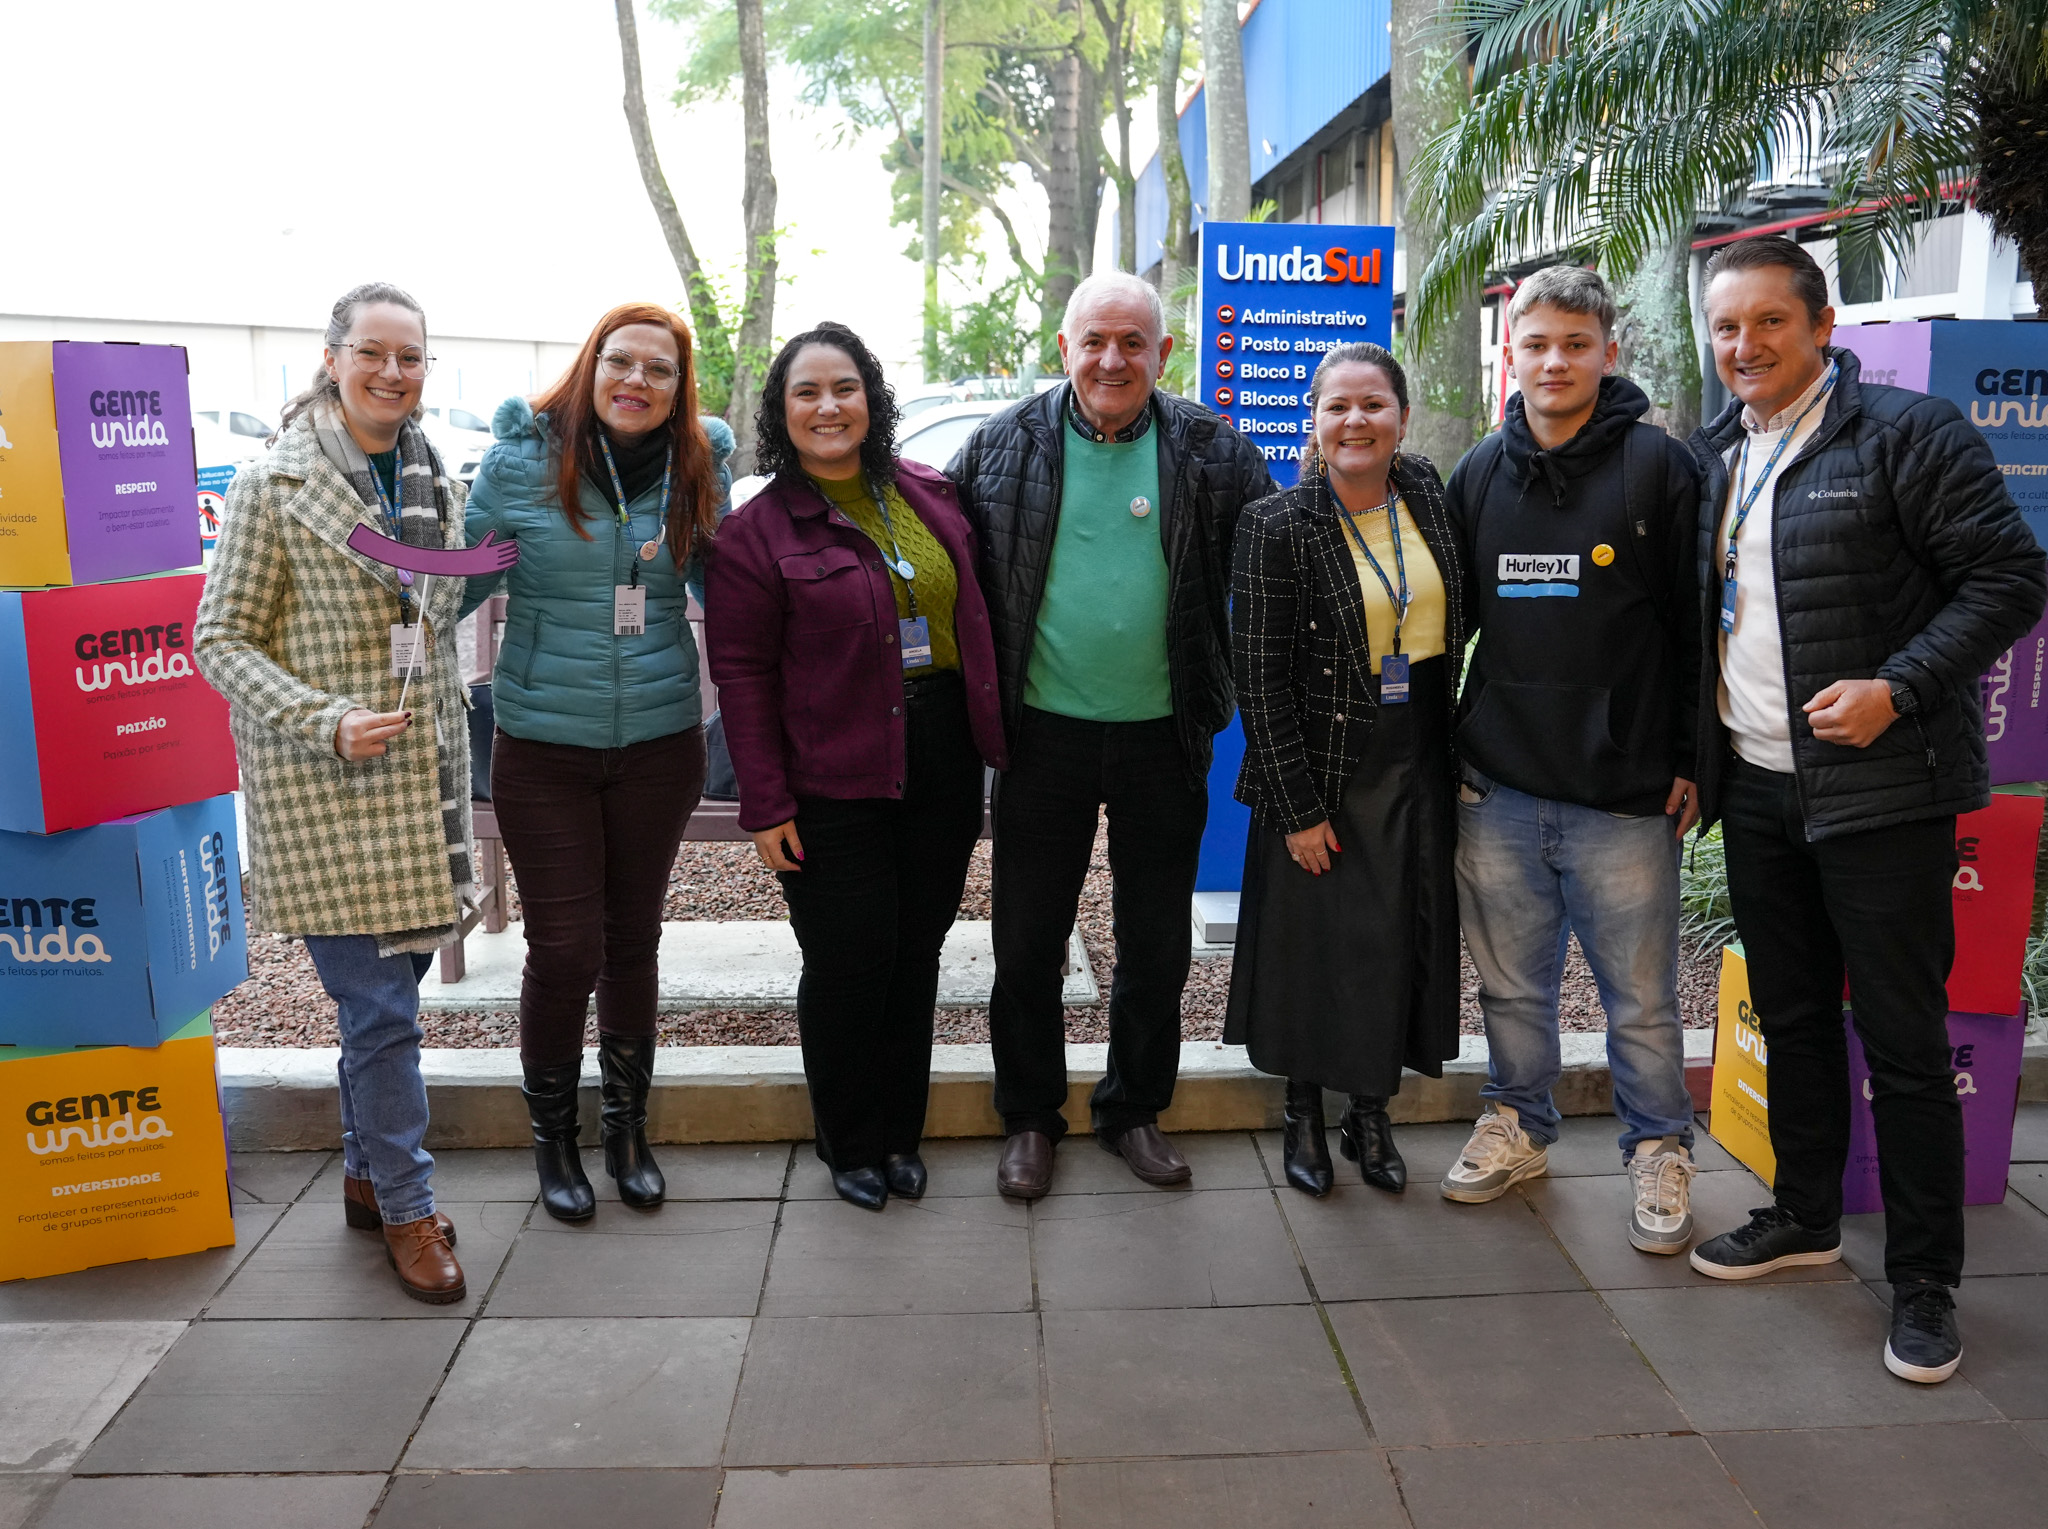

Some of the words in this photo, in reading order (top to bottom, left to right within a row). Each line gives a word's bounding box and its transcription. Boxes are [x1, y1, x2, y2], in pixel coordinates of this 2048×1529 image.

[1217, 244, 1381, 284] UnidaSul
[1241, 308, 1367, 326] Administrativo
[1241, 336, 1290, 352] Posto
[1240, 363, 1290, 379] Bloco
[1294, 365, 1307, 380] B
[89, 390, 163, 417] GENTE
[1239, 391, 1299, 407] Blocos
[90, 413, 170, 449] unida
[1239, 418, 1298, 434] Blocos
[1982, 432, 2009, 441] omos
[2011, 431, 2036, 441] feitos
[98, 453, 119, 461] somos
[119, 451, 136, 459] feitos
[136, 451, 146, 460] por
[115, 481, 157, 495] RESPEITO
[1817, 489, 1858, 499] Columbia
[2018, 491, 2026, 500] a
[98, 510, 131, 521] Impactar
[131, 505, 175, 518] positivamente
[105, 525, 111, 533] o
[112, 521, 145, 533] bem-estar
[1506, 558, 1555, 575] Hurley
[75, 622, 185, 661] GENTE
[75, 648, 194, 692] unida
[2030, 637, 2045, 708] RESPEITO
[86, 693, 117, 704] somos
[117, 689, 141, 699] feitos
[142, 686, 157, 696] por
[116, 716, 167, 736] PAIXÃO
[103, 747, 137, 760] Paixão
[138, 744, 154, 755] por
[200, 835, 221, 961] unida
[212, 831, 231, 946] GENTE
[178, 849, 197, 970] PERTENCIMENTO
[8, 966, 38, 976] feitos
[41, 968, 59, 978] por
[63, 967, 104, 976] muitos.
[25, 1086, 162, 1127] GENTE
[26, 1111, 173, 1155] unida
[39, 1155, 75, 1167] somos
[77, 1149, 105, 1162] feitos
[108, 1148, 126, 1159] por
[128, 1142, 167, 1154] muitos.
[51, 1172, 162, 1197] DIVERSIDADE
[18, 1207, 77, 1224] Fortalecer
[80, 1207, 88, 1215] a
[91, 1189, 200, 1214] representatividade
[43, 1222, 58, 1232] de
[60, 1215, 102, 1231] grupos
[105, 1206, 179, 1223] minorizados.
